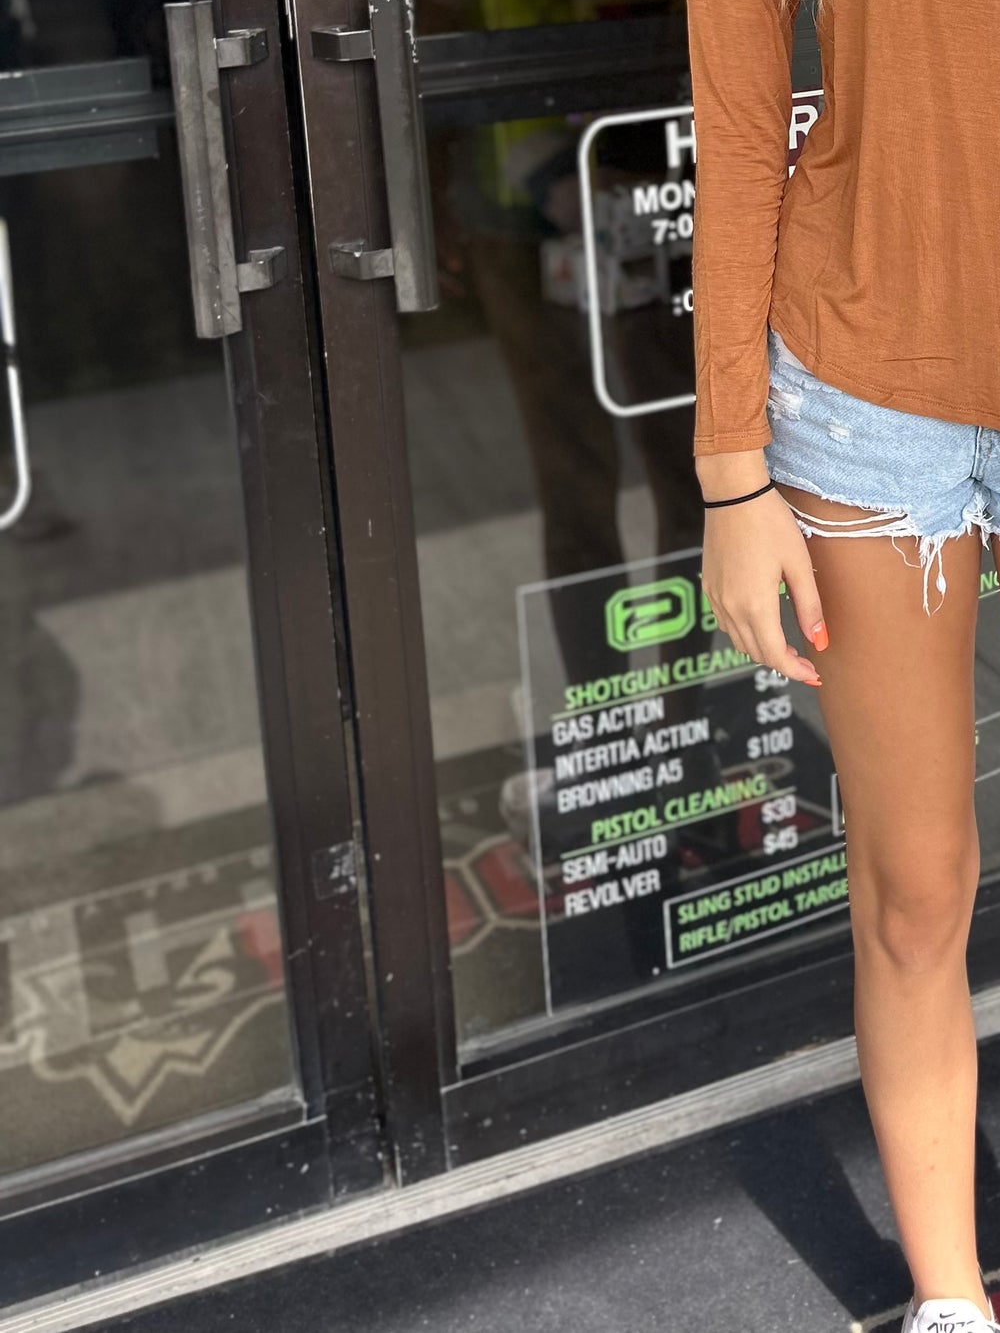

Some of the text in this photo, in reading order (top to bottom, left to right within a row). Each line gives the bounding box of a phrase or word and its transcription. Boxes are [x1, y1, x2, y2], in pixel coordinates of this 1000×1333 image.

[633, 179, 696, 215] MON
[652, 213, 694, 245] 7:0
[552, 714, 594, 746] GAS
[597, 696, 665, 736] ACTION
[565, 663, 669, 710] SHOTGUN
[555, 694, 793, 780] INTERTIA ACTION $35
[557, 726, 793, 813] BROWNING A5 $100
[562, 795, 797, 884] SEMI-AUTO $30
[591, 773, 767, 843] PISTOL CLEANING
[564, 825, 798, 917] REVOLVER $45
[678, 891, 732, 925] SLING
[733, 875, 781, 906] STUD
[679, 878, 849, 953] RIFLE/PISTOL TARGE
